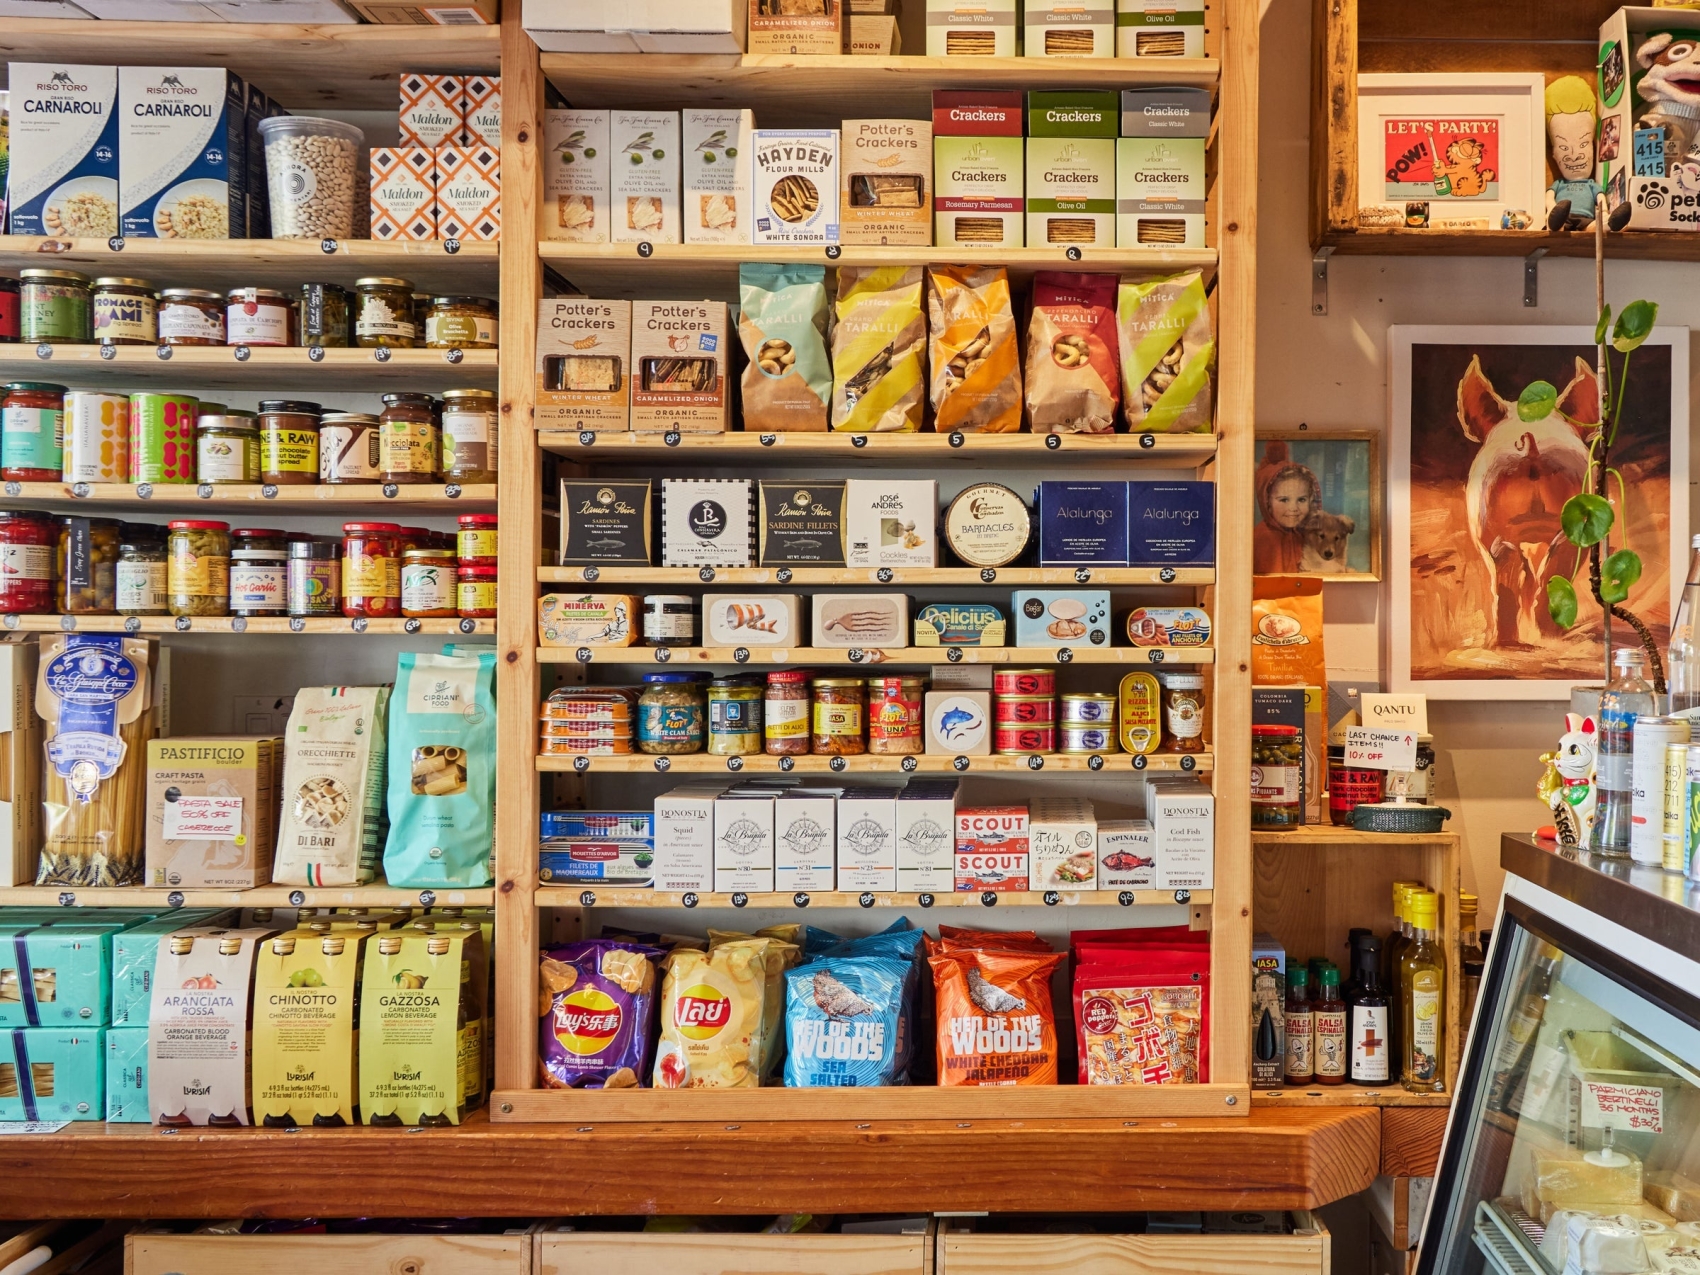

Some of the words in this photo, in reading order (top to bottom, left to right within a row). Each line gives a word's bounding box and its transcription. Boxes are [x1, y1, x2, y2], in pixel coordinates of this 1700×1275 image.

[24, 100, 102, 115] CARNAROLI
[134, 103, 212, 117] CARNAROLI
[1144, 107, 1190, 116] Crackers
[410, 113, 454, 126] Maldon
[950, 110, 1005, 122] Crackers
[1047, 111, 1101, 122] Crackers
[860, 125, 913, 135] Potter's
[1387, 122, 1434, 134] LET'S
[1439, 122, 1496, 134] PARTY!
[856, 138, 917, 148] Crackers
[1636, 142, 1663, 156] 415
[757, 148, 833, 167] HAYDEN
[1386, 142, 1428, 183] POW!
[1637, 162, 1664, 176] 415
[952, 171, 1006, 182] Crackers
[1044, 172, 1098, 183] Crackers
[1135, 172, 1189, 183] Crackers
[381, 188, 425, 199] Maldon
[447, 188, 491, 199] Maldon
[945, 201, 978, 210] Rosemary
[641, 244, 648, 254] 9
[110, 308, 142, 322] AMI
[556, 304, 611, 315] Potter's
[651, 306, 707, 317] Potter's
[551, 318, 615, 329] Crackers
[647, 320, 710, 330] Crackers
[1045, 315, 1098, 324] TARALLI
[845, 323, 898, 333] TARALLI
[1132, 319, 1185, 332] TARALLI
[953, 435, 961, 444] 5
[1049, 437, 1056, 446] 5
[1144, 437, 1152, 446] 5
[1056, 506, 1113, 524] Alalunga
[1143, 508, 1199, 526] Alalunga
[962, 523, 1014, 533] BARNACLES
[982, 570, 994, 579] 35
[1267, 662, 1293, 671] Timilia
[1373, 705, 1416, 716] QANTU
[160, 748, 244, 760] PASTIFICIO
[1135, 755, 1143, 767] 6
[1183, 757, 1191, 767] 8
[178, 799, 211, 808] PASTA
[216, 800, 241, 808] SALE
[181, 810, 208, 819] 50%
[961, 817, 1024, 831] SCOUT
[1034, 830, 1062, 842] オイル
[1106, 835, 1148, 844] ESPINALER
[1036, 843, 1074, 854] ちりめん
[960, 856, 1022, 870] SCOUT
[292, 890, 300, 903] 6
[921, 895, 930, 903] 15
[1257, 959, 1278, 967] IASA
[164, 997, 234, 1006] ARANCIATA
[269, 995, 336, 1005] CHINOTTO
[380, 997, 440, 1006] GAZZOSA
[182, 1007, 214, 1015] ROSSA
[794, 1020, 826, 1035] HEN
[830, 1022, 850, 1037] OF
[853, 1022, 885, 1036] THE
[951, 1016, 985, 1032] HEN
[987, 1018, 1007, 1032] OF
[1011, 1015, 1041, 1031] THE
[1287, 1019, 1311, 1027] SALSA
[1318, 1019, 1343, 1027] SALSA
[950, 1029, 1042, 1056] WOODS
[1124, 992, 1172, 1084] ゴボチ
[793, 1034, 884, 1061] WOODS
[822, 1061, 846, 1073] SEA
[946, 1054, 986, 1070] WHITE
[989, 1053, 1048, 1067] CHEDDAR
[810, 1074, 857, 1086] SALTED
[1597, 1094, 1658, 1106] BERTINELLI
[1599, 1103, 1614, 1112] 36
[1617, 1105, 1659, 1115] MONTHS
